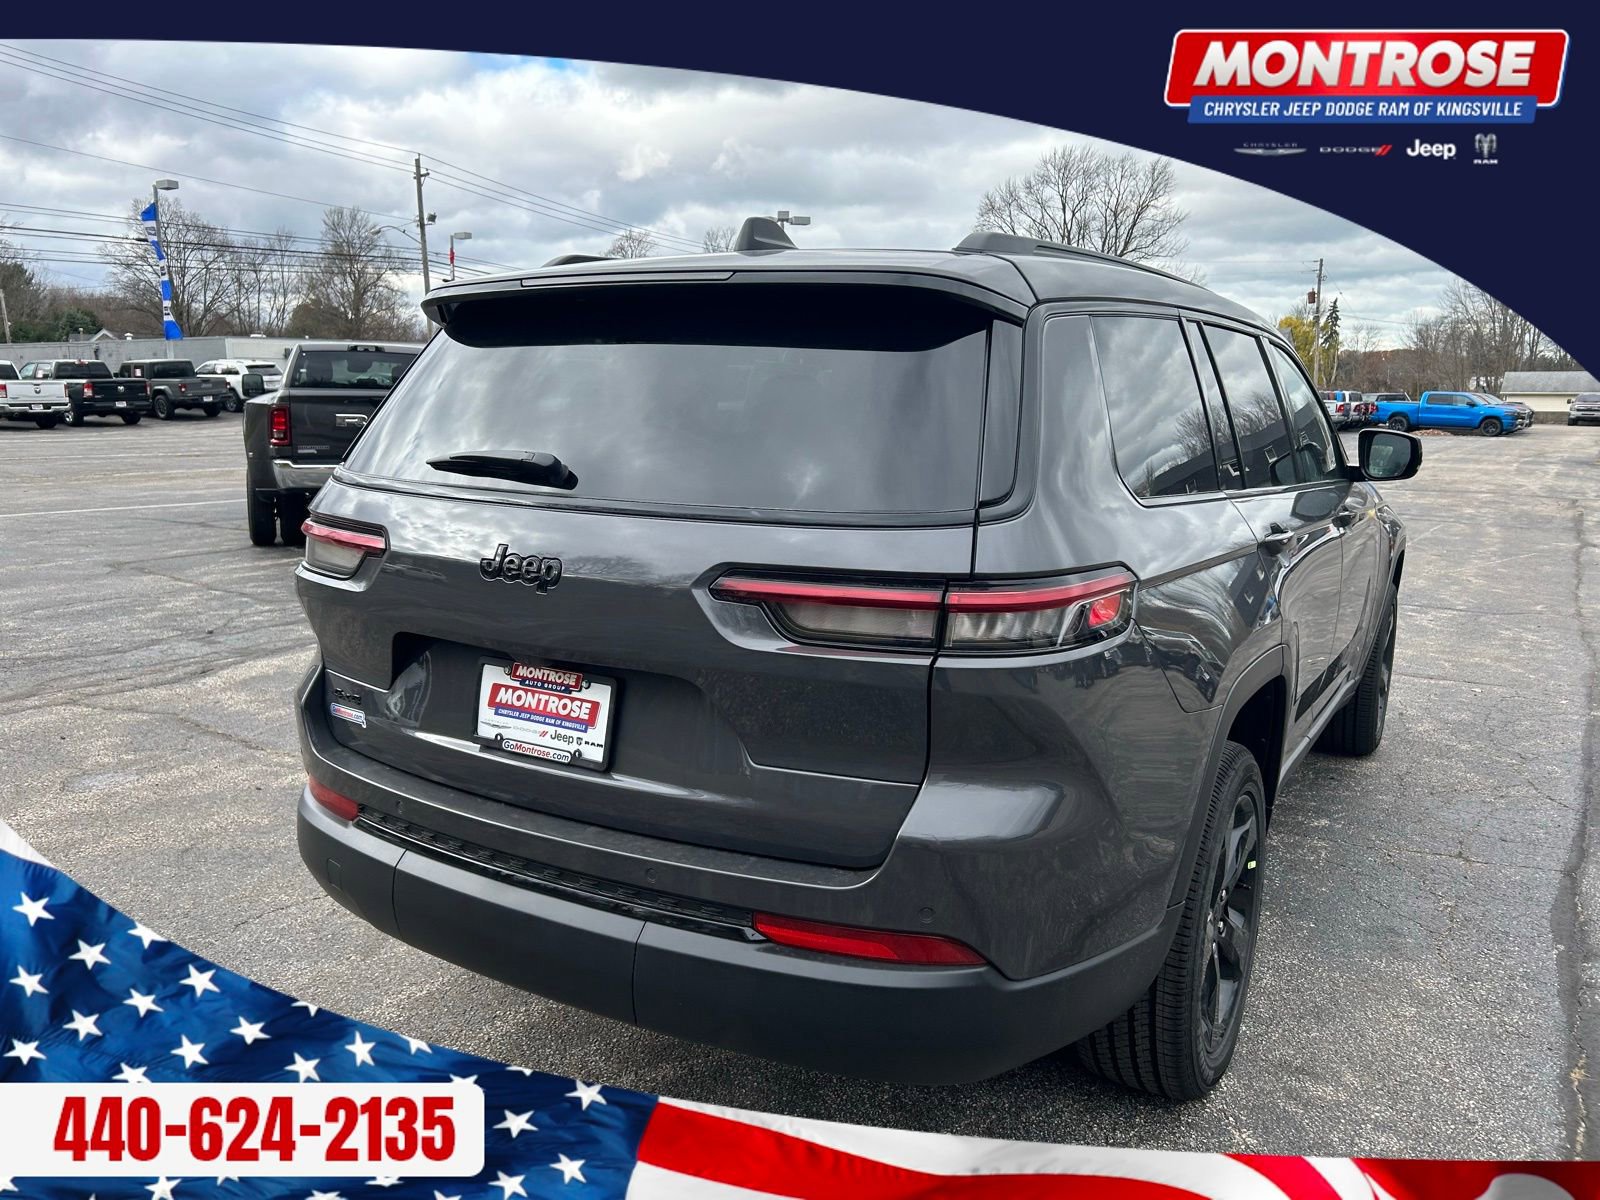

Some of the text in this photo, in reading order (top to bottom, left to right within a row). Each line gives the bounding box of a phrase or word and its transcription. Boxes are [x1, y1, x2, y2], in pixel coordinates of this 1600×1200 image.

[480, 544, 563, 595] Jeep
[516, 665, 577, 686] MONTROSE
[544, 682, 566, 691] GROUP
[495, 687, 593, 720] MONTROSE
[550, 730, 575, 746] Jeep
[503, 740, 570, 763] GoMontrose.com
